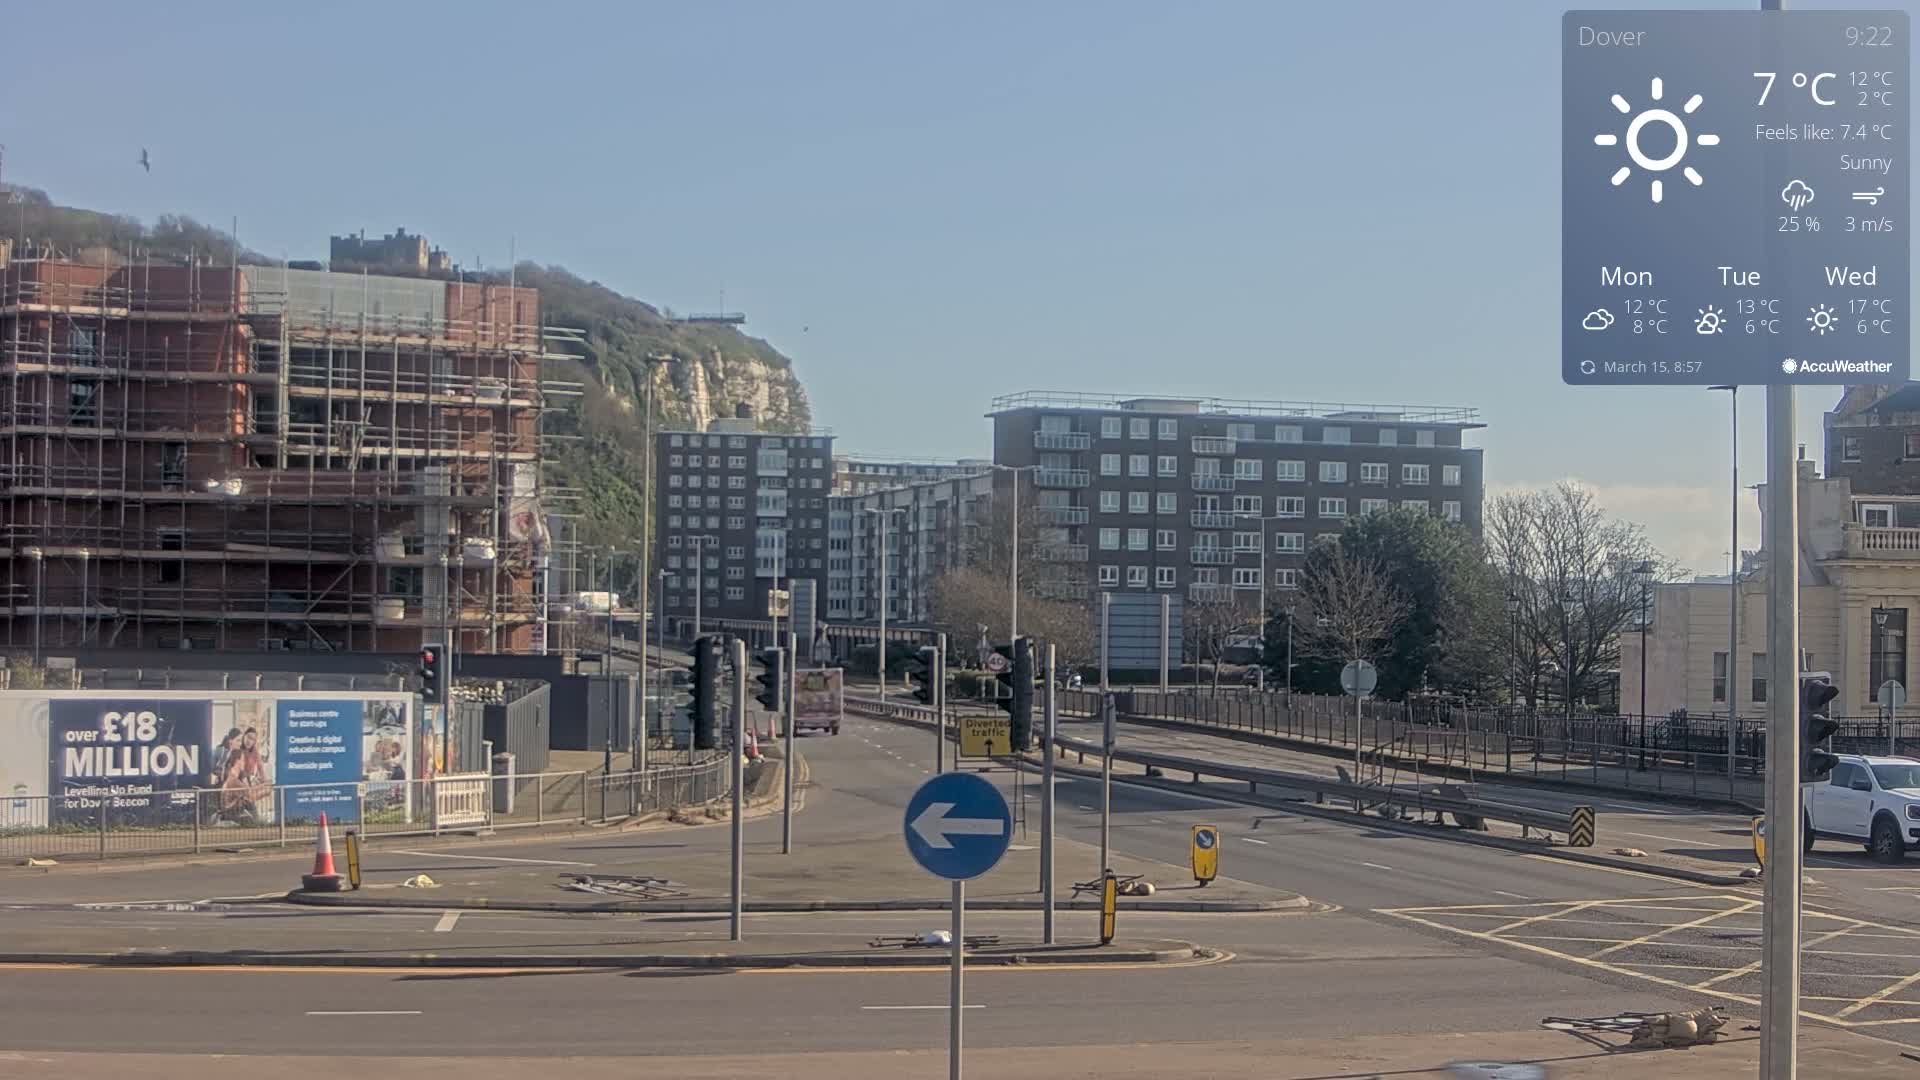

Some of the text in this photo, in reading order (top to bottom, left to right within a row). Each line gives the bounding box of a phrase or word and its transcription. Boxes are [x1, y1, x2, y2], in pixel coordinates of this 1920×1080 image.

[288, 709, 318, 718] Business
[65, 711, 158, 742] over £18
[972, 728, 1005, 736] traffic
[322, 735, 342, 744] digital
[65, 745, 199, 777] MILLION
[64, 784, 153, 798] Levelling Up Fund
[64, 799, 79, 808] for
[113, 797, 150, 808] Beacon
